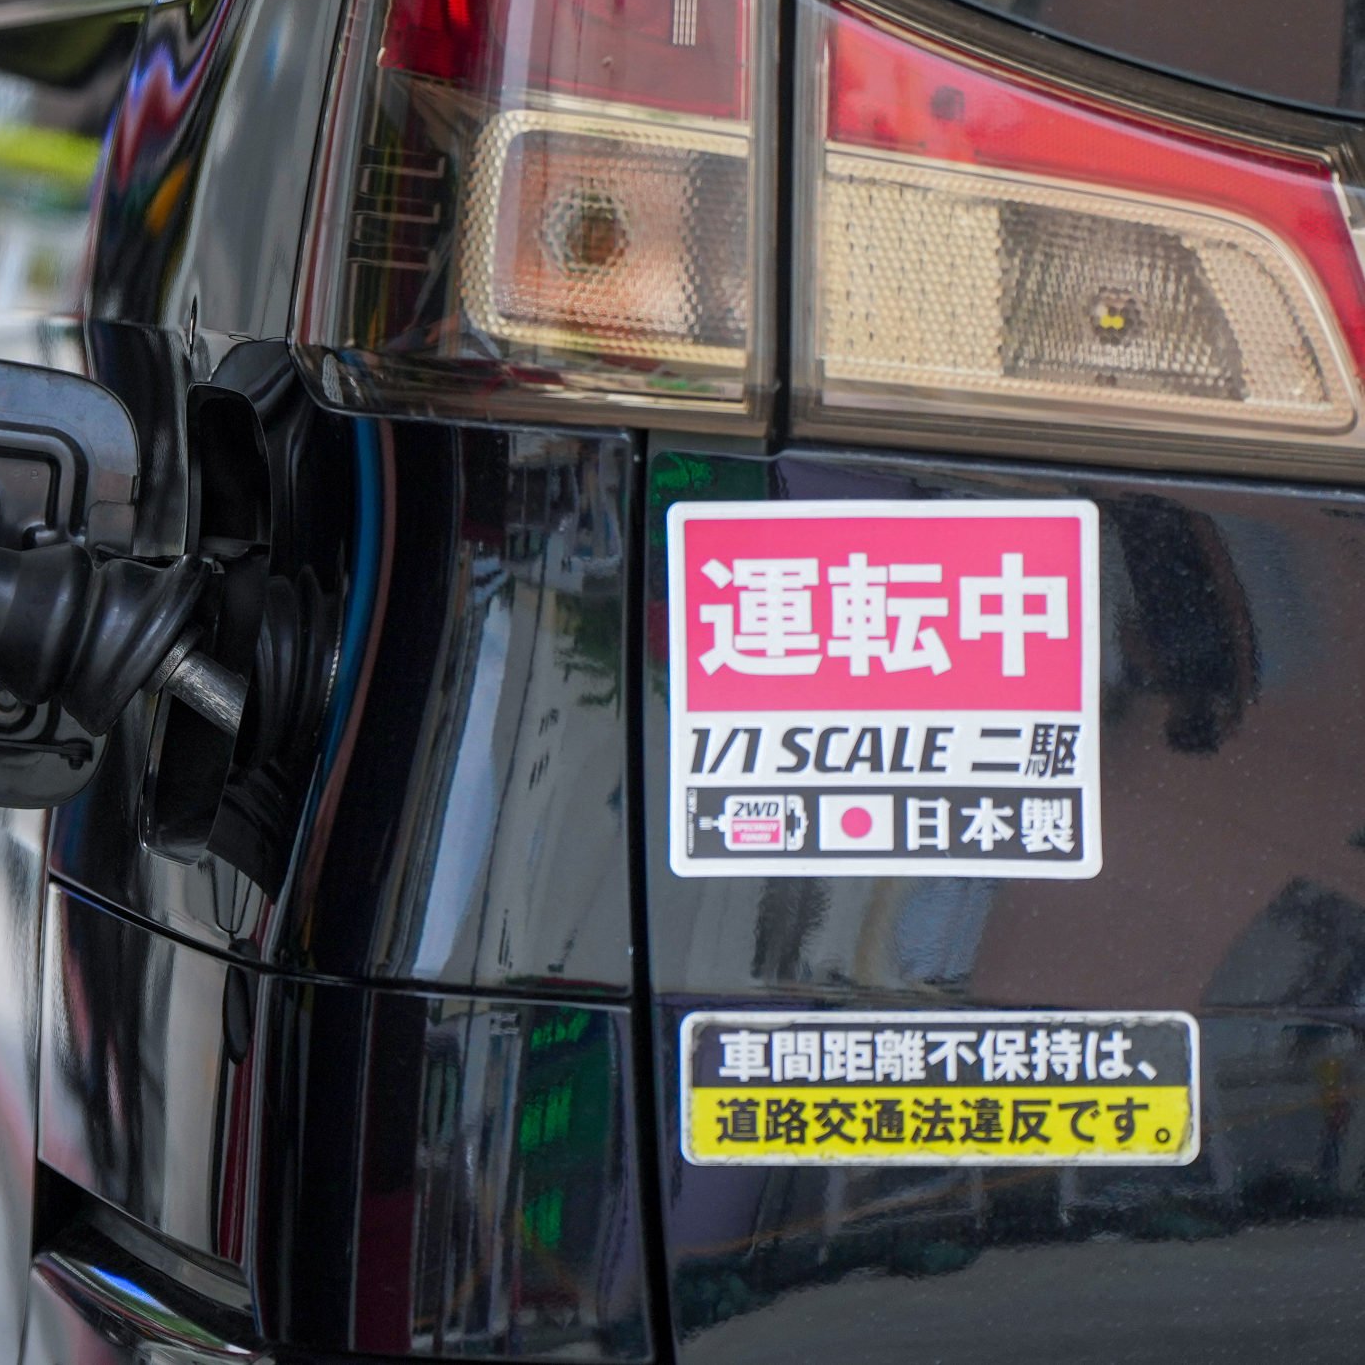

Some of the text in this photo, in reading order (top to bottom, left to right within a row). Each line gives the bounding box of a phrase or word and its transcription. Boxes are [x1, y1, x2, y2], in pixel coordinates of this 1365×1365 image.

[698, 552, 1069, 677] 運転中
[776, 726, 954, 775] SCALE
[970, 723, 1082, 779] 二駆
[733, 801, 780, 817] 2WD
[905, 796, 1076, 854] 日本製
[718, 1028, 1159, 1083] 車間距離不保持は、
[714, 1096, 1172, 1146] 道路交通法違反です。
